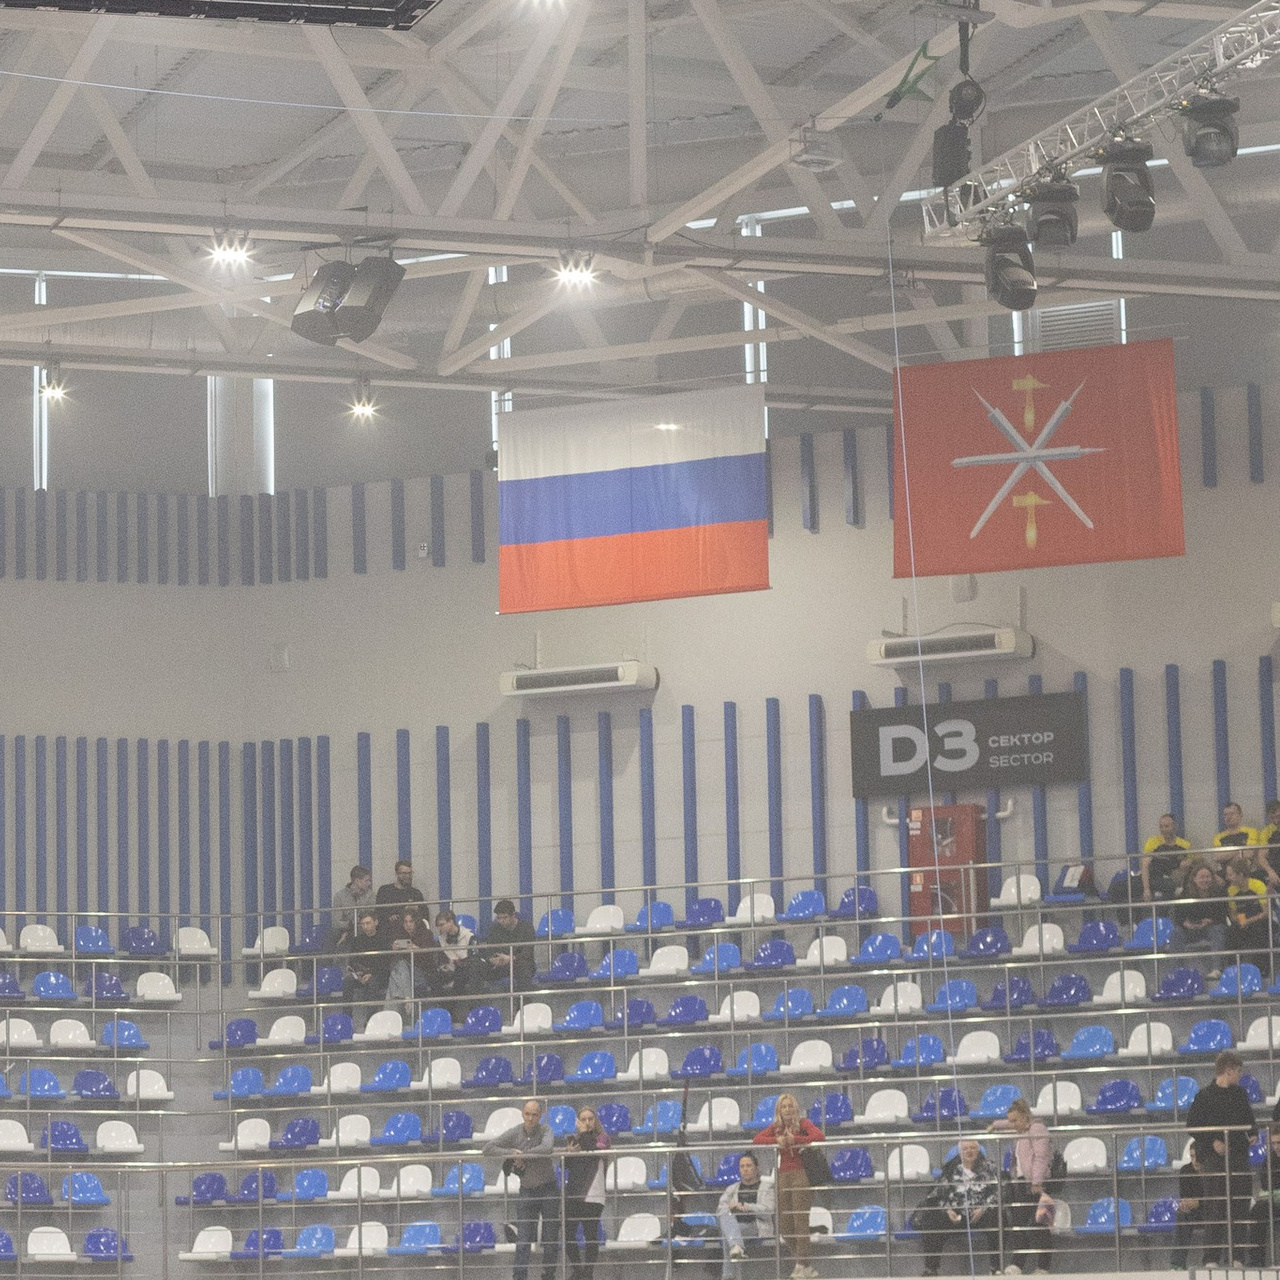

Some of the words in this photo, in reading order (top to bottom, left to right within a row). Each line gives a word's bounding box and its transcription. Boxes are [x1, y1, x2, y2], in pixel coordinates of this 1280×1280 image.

[877, 719, 980, 777] D3
[988, 731, 1055, 748] СЕКТОР
[988, 752, 1055, 769] SECTOR
